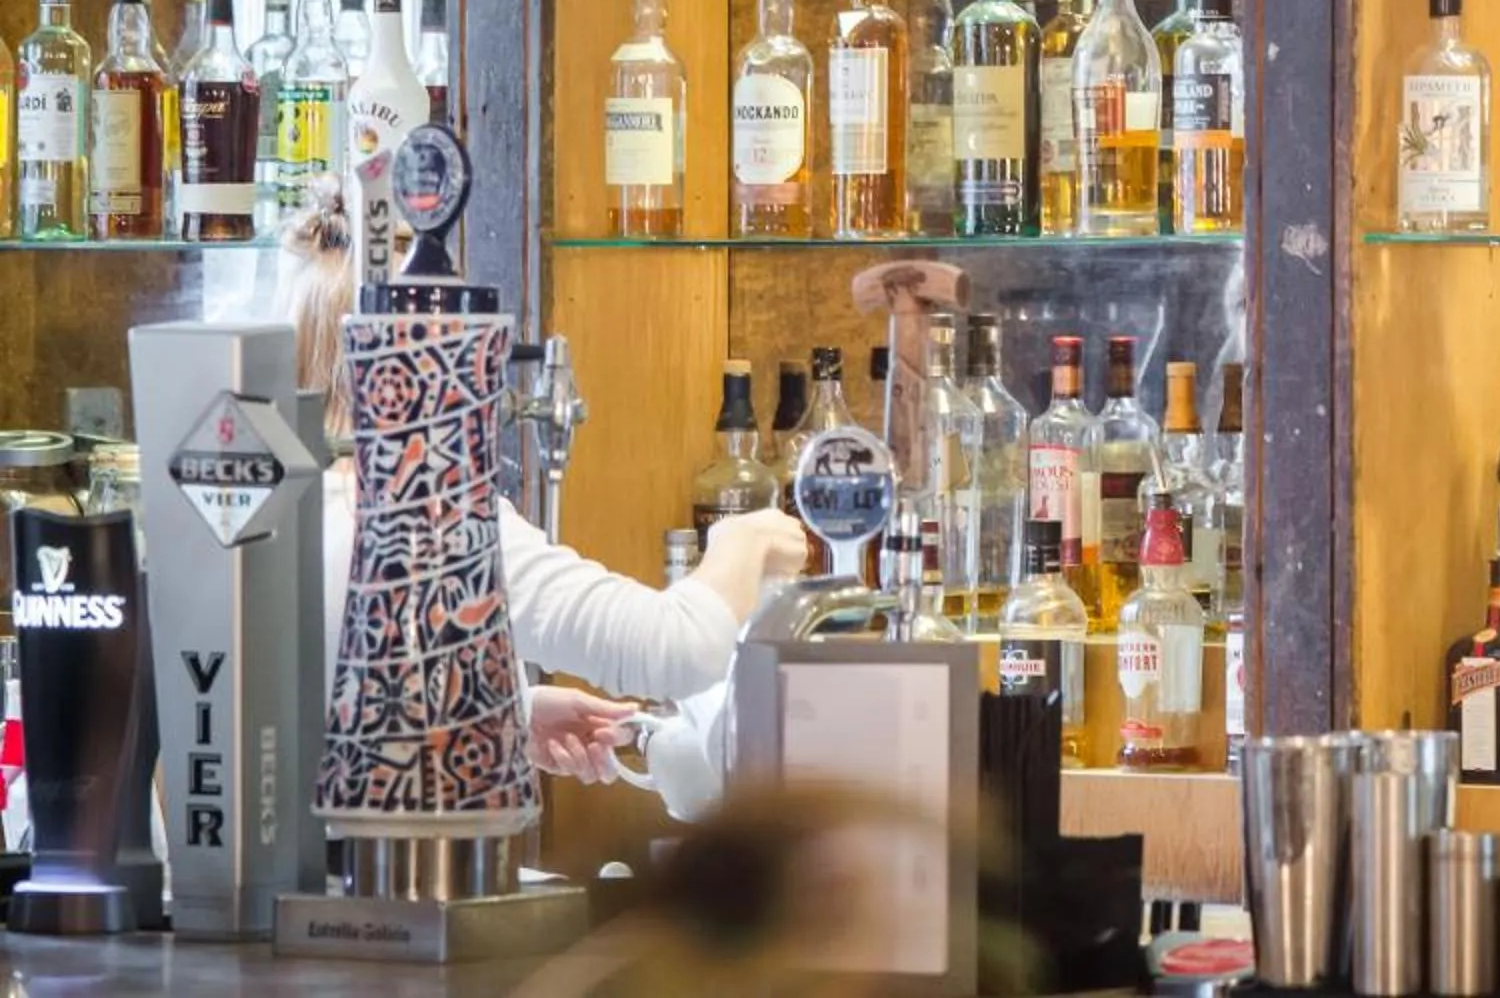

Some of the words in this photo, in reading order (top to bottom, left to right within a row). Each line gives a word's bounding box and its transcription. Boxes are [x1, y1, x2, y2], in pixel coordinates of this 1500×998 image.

[368, 198, 389, 284] ECKS
[201, 492, 252, 507] VIER
[180, 650, 226, 847] VIER
